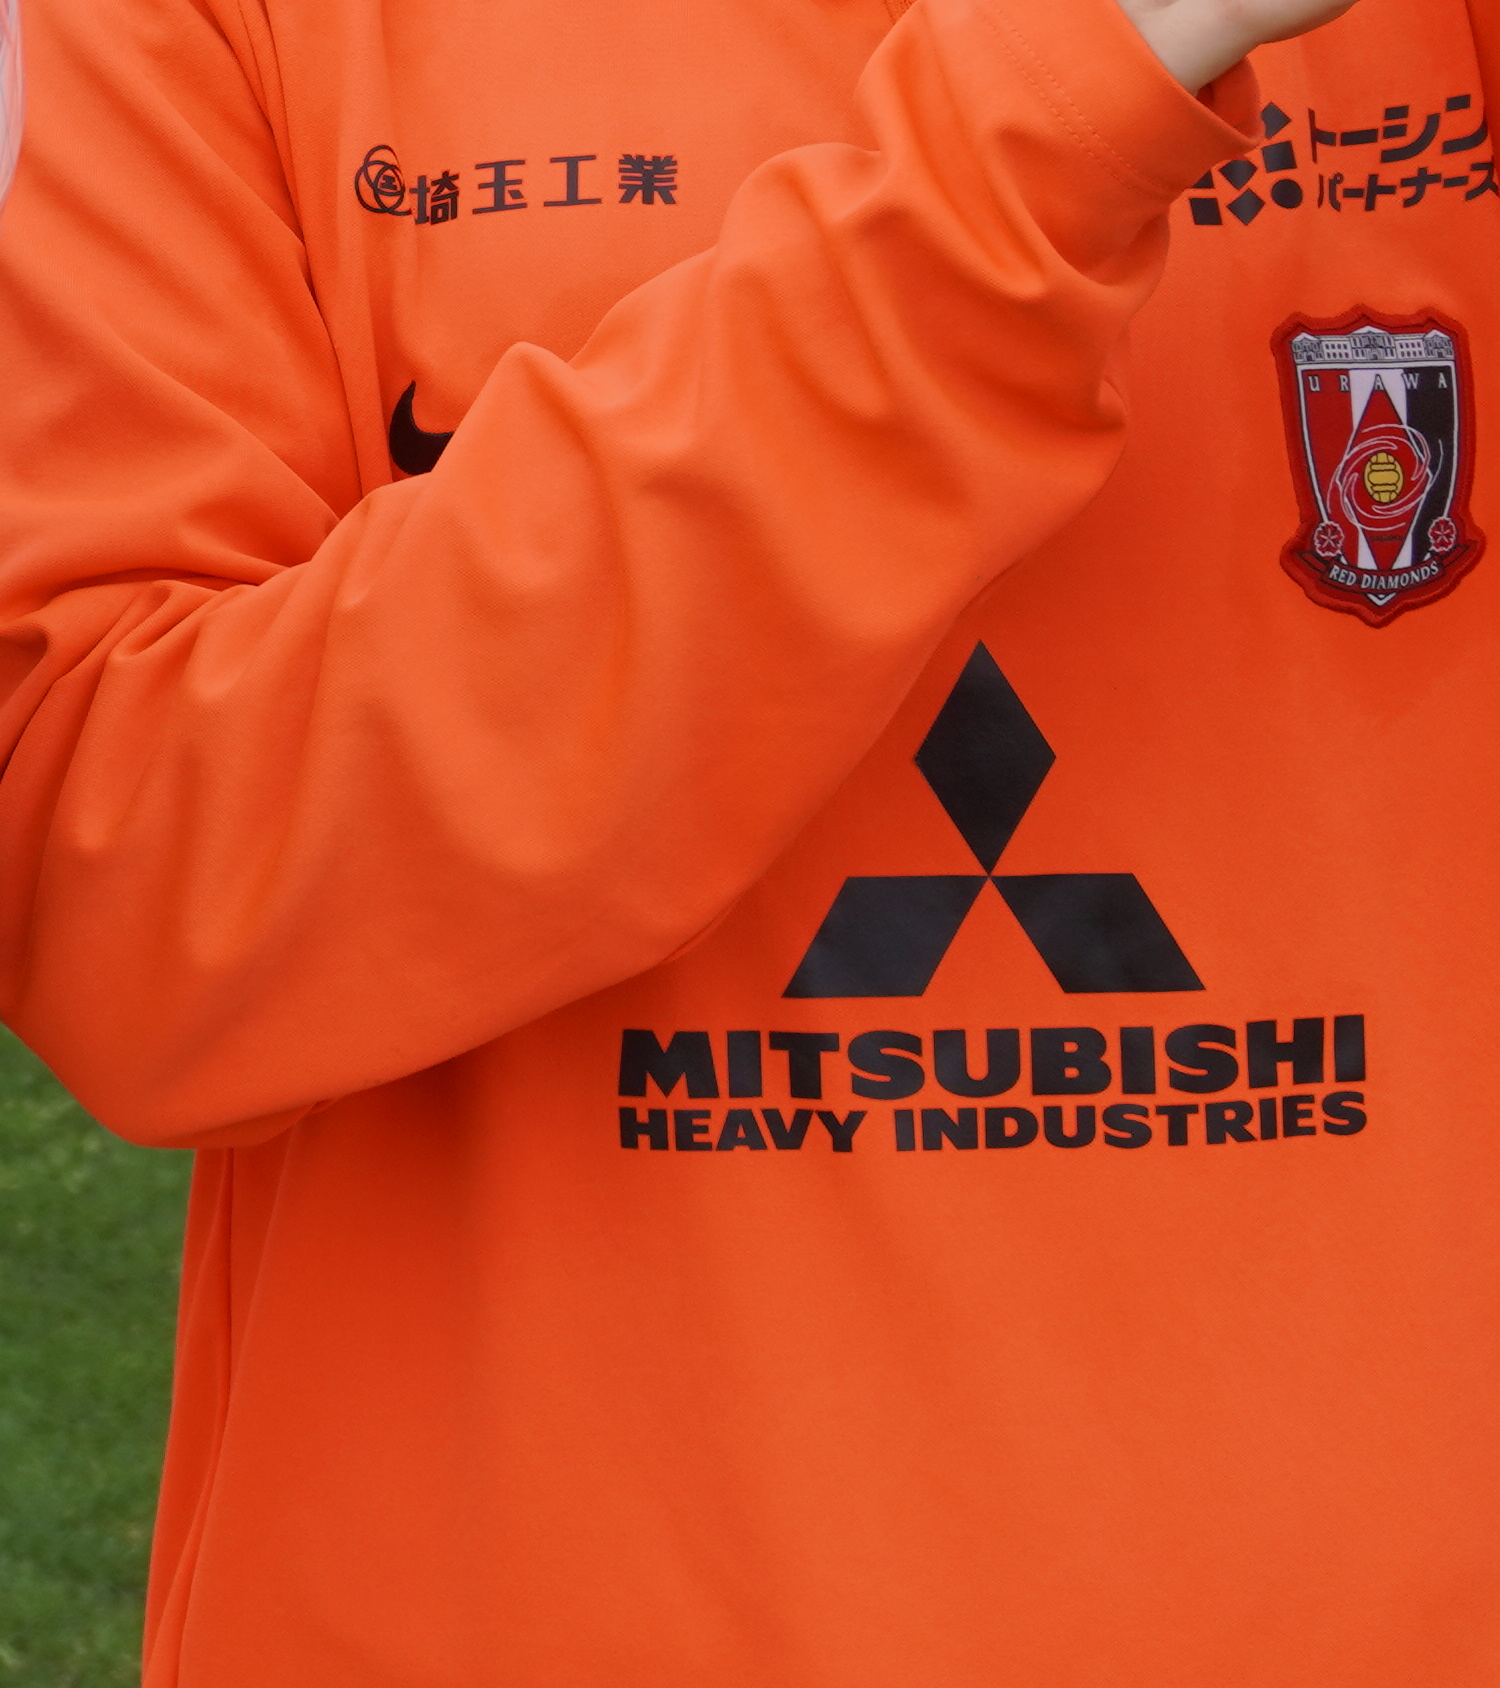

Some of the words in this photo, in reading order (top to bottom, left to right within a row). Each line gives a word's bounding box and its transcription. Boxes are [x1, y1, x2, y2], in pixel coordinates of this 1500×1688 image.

[1308, 94, 1488, 164] トーシン
[409, 154, 678, 226] 埼玉工業
[1308, 372, 1448, 393] URAWA
[1329, 564, 1357, 587] RED
[1360, 560, 1440, 590] DIAMONDS
[617, 1014, 1367, 1100] MITSUBISHI
[618, 1107, 867, 1153] HEAVY
[895, 1091, 1368, 1152] INDUSTRIES
